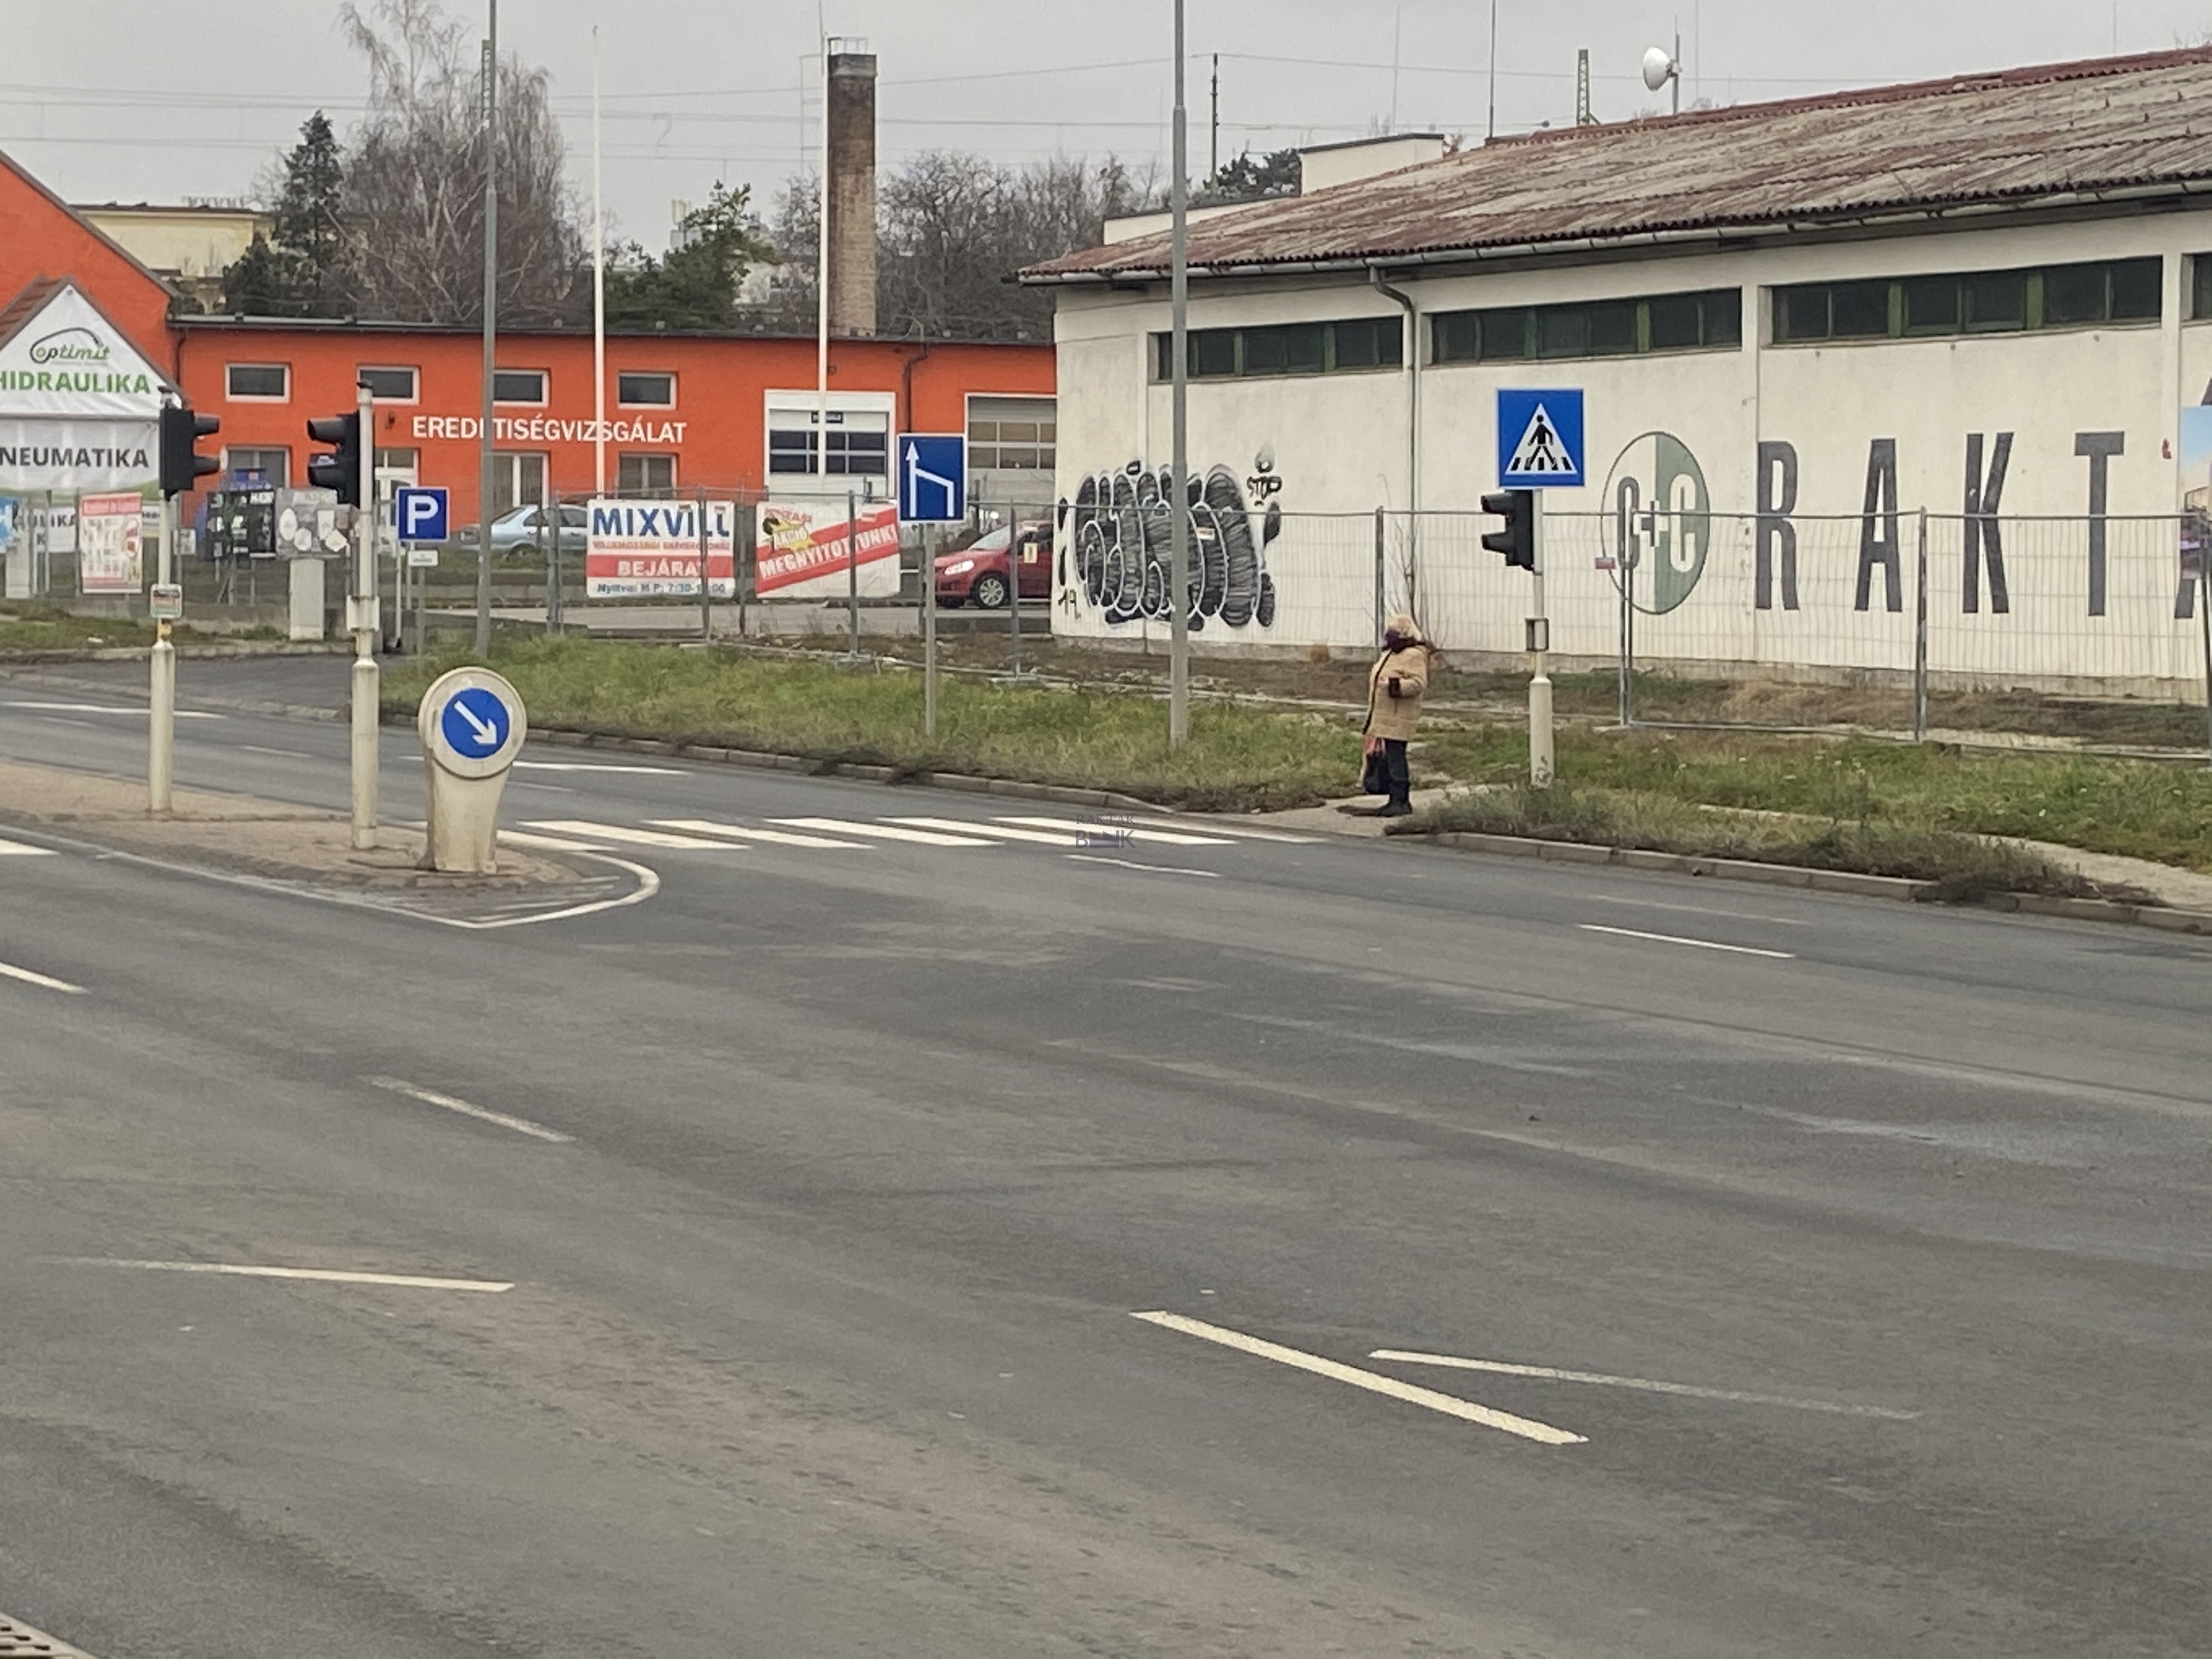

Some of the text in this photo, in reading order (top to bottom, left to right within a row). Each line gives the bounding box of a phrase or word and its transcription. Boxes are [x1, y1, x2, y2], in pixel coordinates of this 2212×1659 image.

[413, 414, 686, 443] EREDTISÉGVIZSGÁLAT
[407, 495, 438, 534] P
[1755, 430, 2212, 619] RAKT
